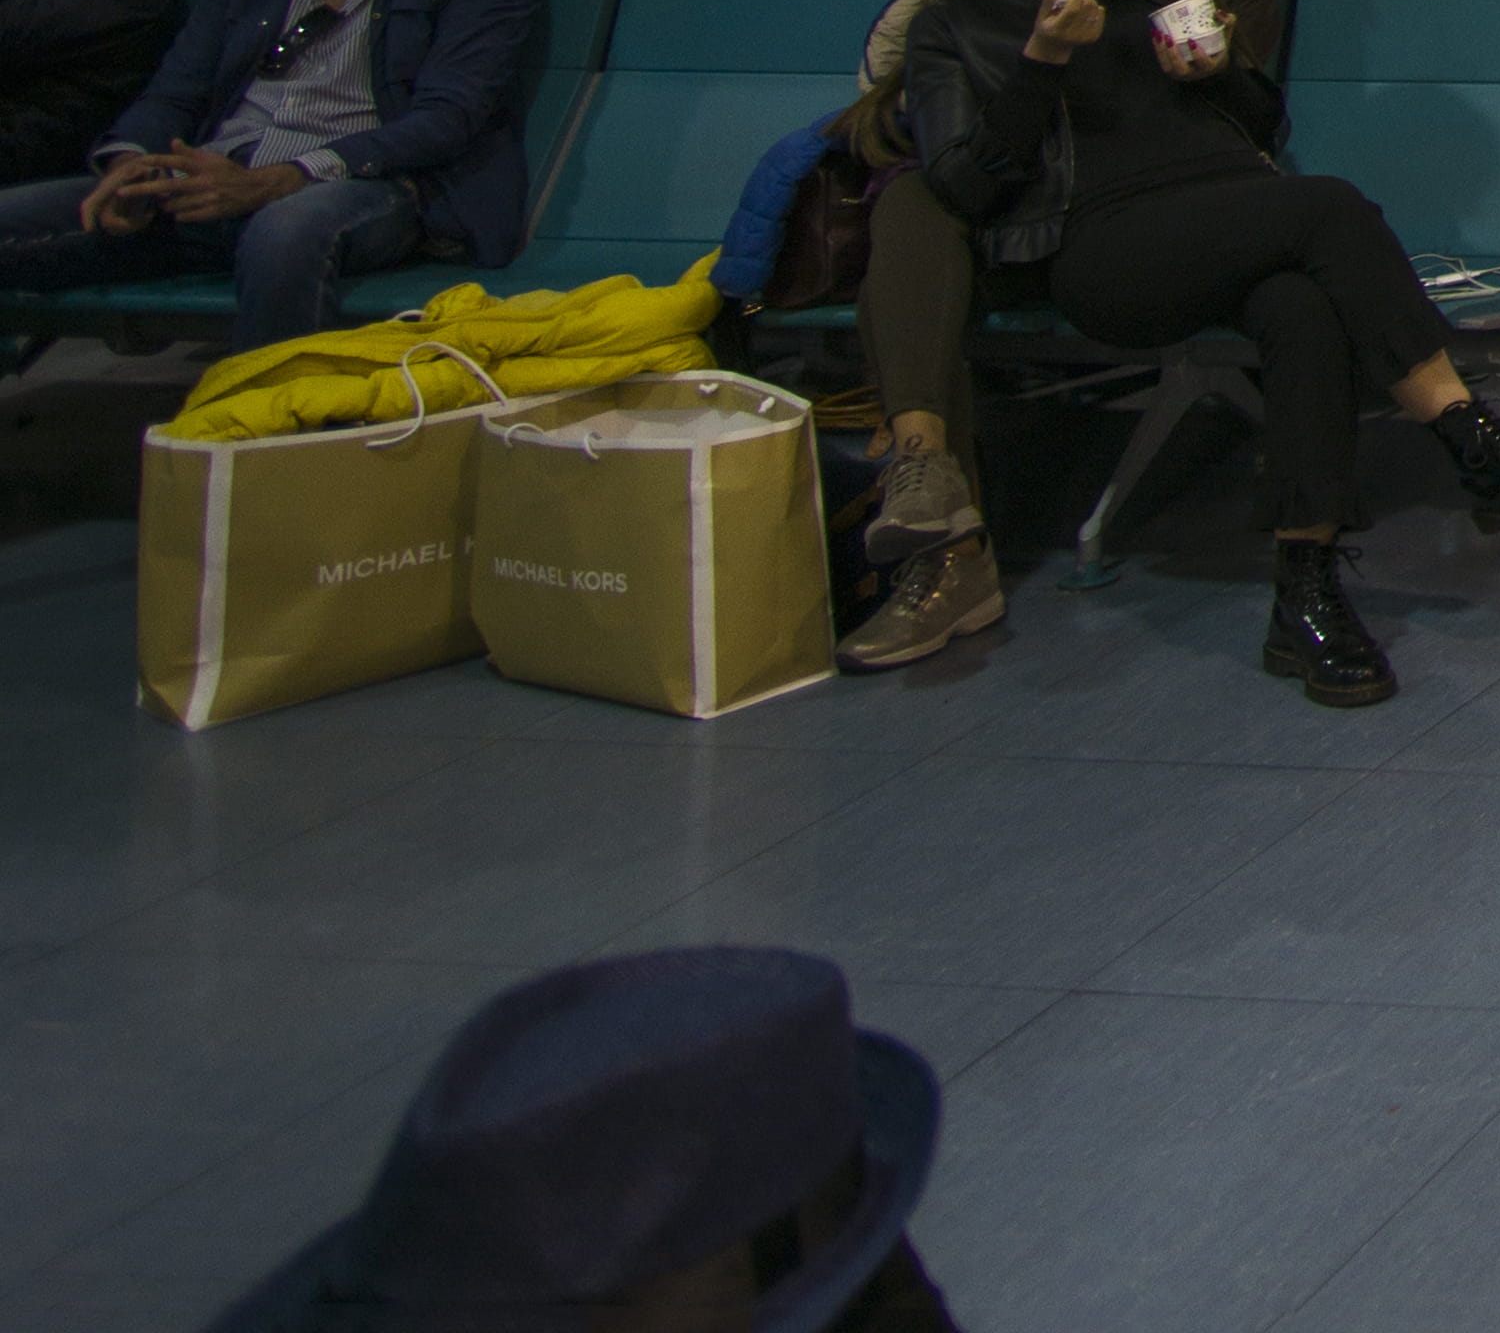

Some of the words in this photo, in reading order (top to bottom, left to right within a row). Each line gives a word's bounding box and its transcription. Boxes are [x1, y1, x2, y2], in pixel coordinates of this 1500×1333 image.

[317, 540, 453, 584] MICHAEL
[495, 557, 567, 589] MICHAEL
[571, 570, 629, 595] KORS
